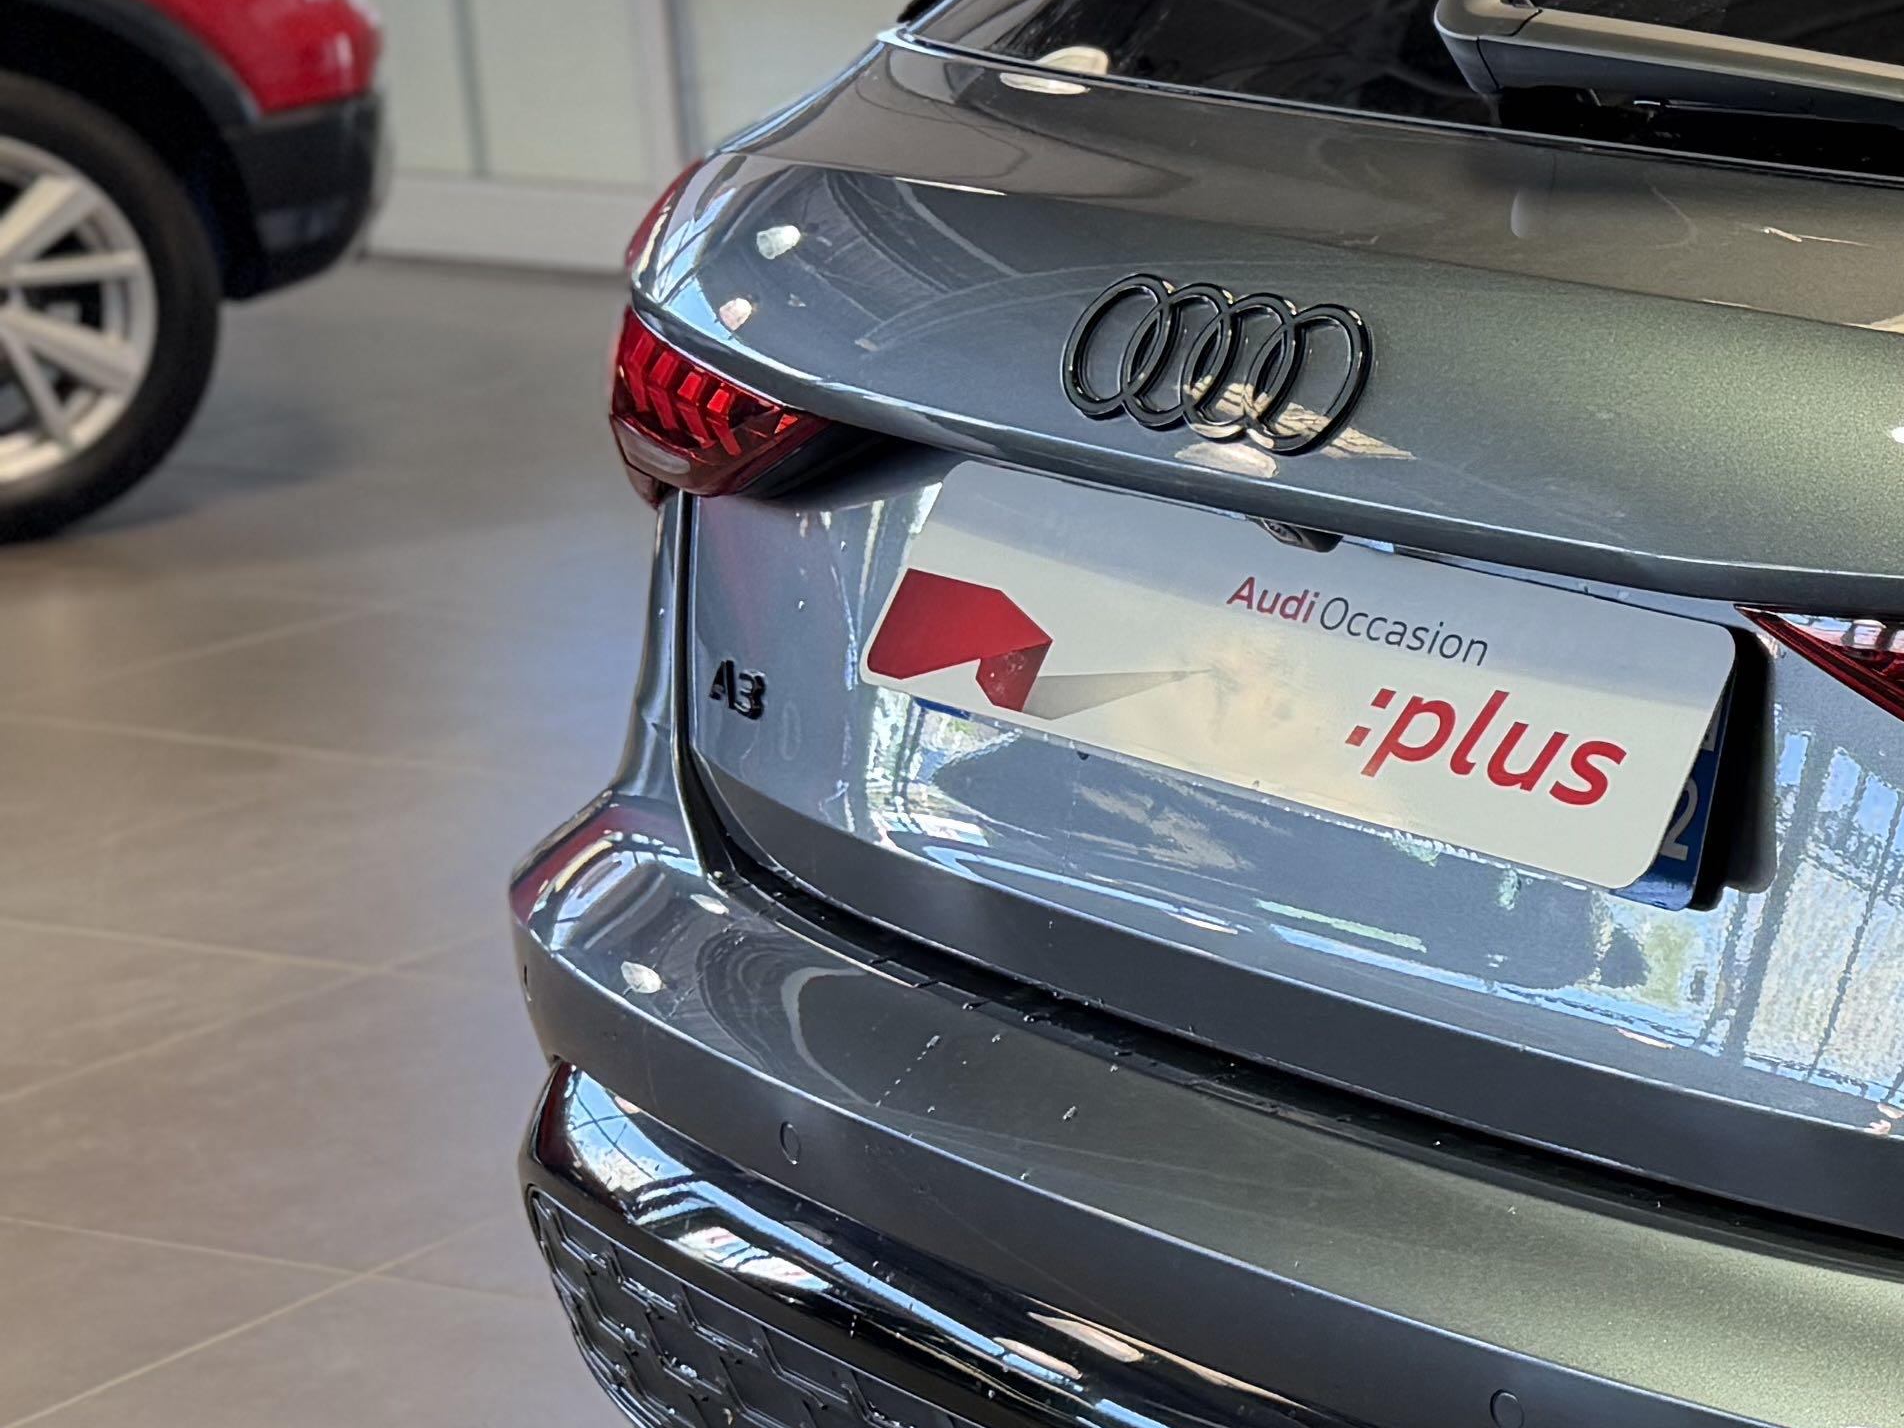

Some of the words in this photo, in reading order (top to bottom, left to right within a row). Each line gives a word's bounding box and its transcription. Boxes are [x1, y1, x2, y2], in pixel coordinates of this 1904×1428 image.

[1226, 576, 1320, 624] Audi
[1319, 596, 1489, 667] Occasion
[708, 658, 767, 721] A3
